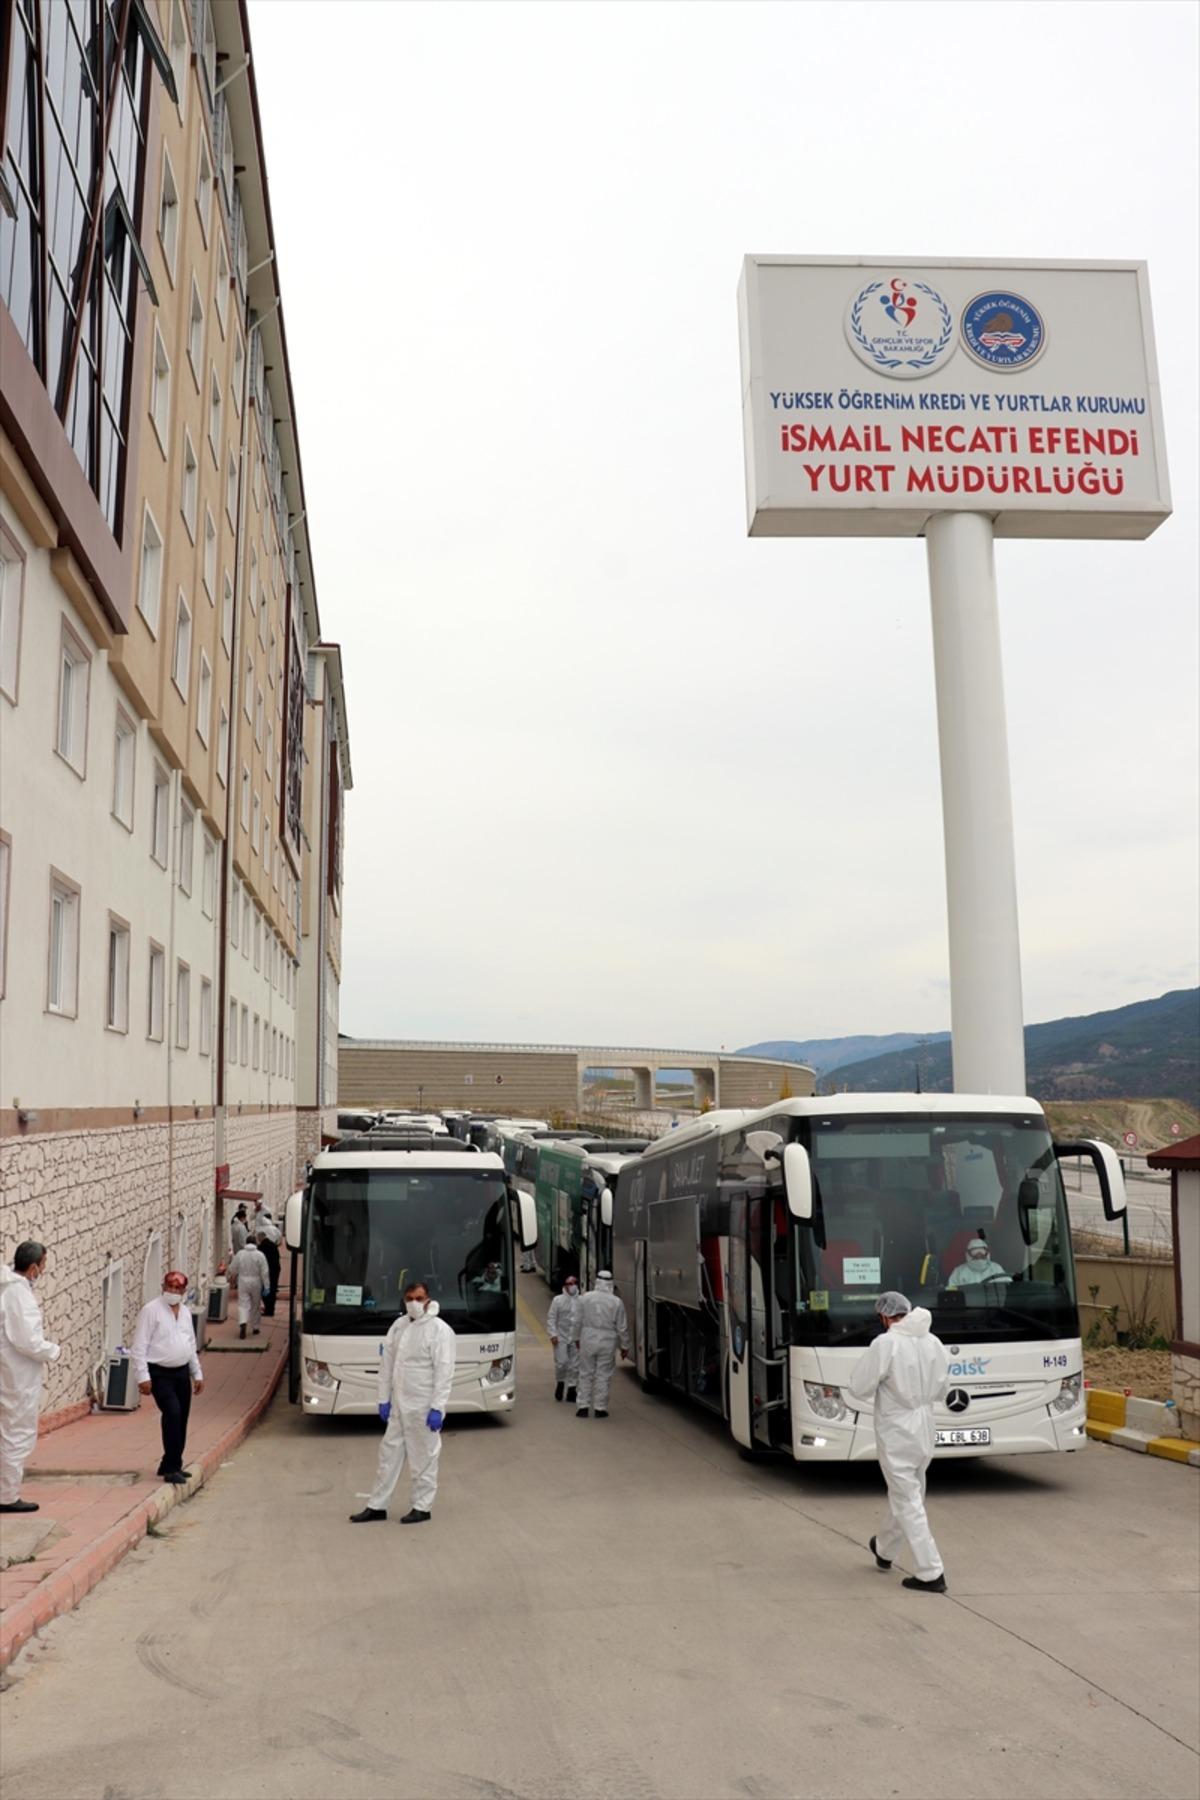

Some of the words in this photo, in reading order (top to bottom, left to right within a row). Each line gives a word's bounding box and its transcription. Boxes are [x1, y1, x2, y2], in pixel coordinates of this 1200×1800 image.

[770, 392, 834, 410] YÜKSEK
[919, 393, 966, 411] KREDİ
[970, 394, 990, 411] VE
[995, 394, 1073, 413] YURTLAR
[1077, 397, 1146, 415] KURUMU
[781, 424, 891, 452] İSMAİL
[901, 425, 1018, 454] NECATİ
[1028, 427, 1139, 456] EFENDİ
[803, 464, 896, 492] YURT
[907, 462, 1124, 496] MÜDÜRLÜĞÜ
[1043, 1355, 1067, 1367] H-149
[970, 1430, 988, 1441] 638
